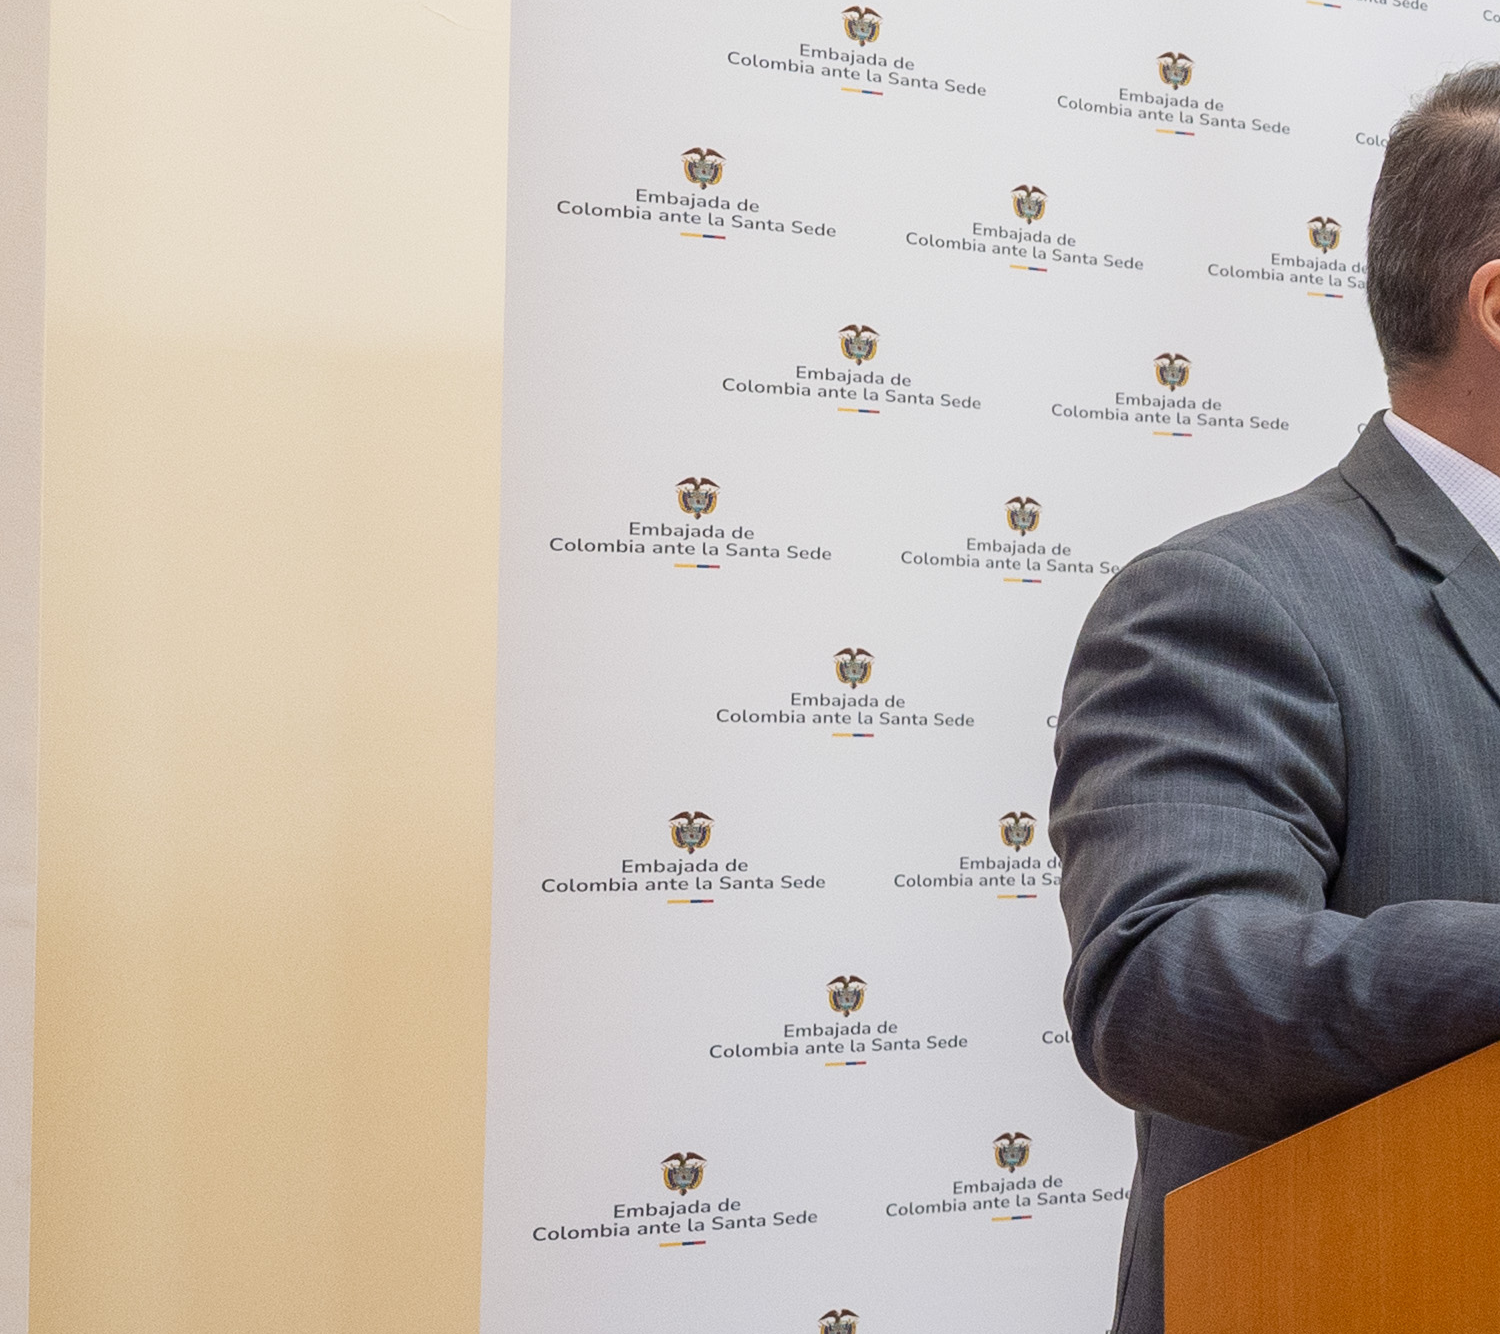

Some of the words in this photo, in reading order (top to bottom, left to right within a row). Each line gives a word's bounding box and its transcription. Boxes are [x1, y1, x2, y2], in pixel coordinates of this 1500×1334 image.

[800, 43, 887, 67] Embajada
[893, 57, 914, 70] de
[727, 51, 814, 74] Colombia
[821, 67, 860, 80] ante
[867, 69, 882, 83] la
[888, 72, 938, 90] Santa
[945, 79, 986, 96] Sede
[614, 1200, 711, 1219] Embajada
[718, 1198, 741, 1212] de
[533, 1223, 630, 1241] Colombia
[637, 1221, 681, 1235] ante
[688, 1218, 704, 1232] la
[712, 1215, 766, 1230] Santa
[773, 1210, 817, 1226] Sede
